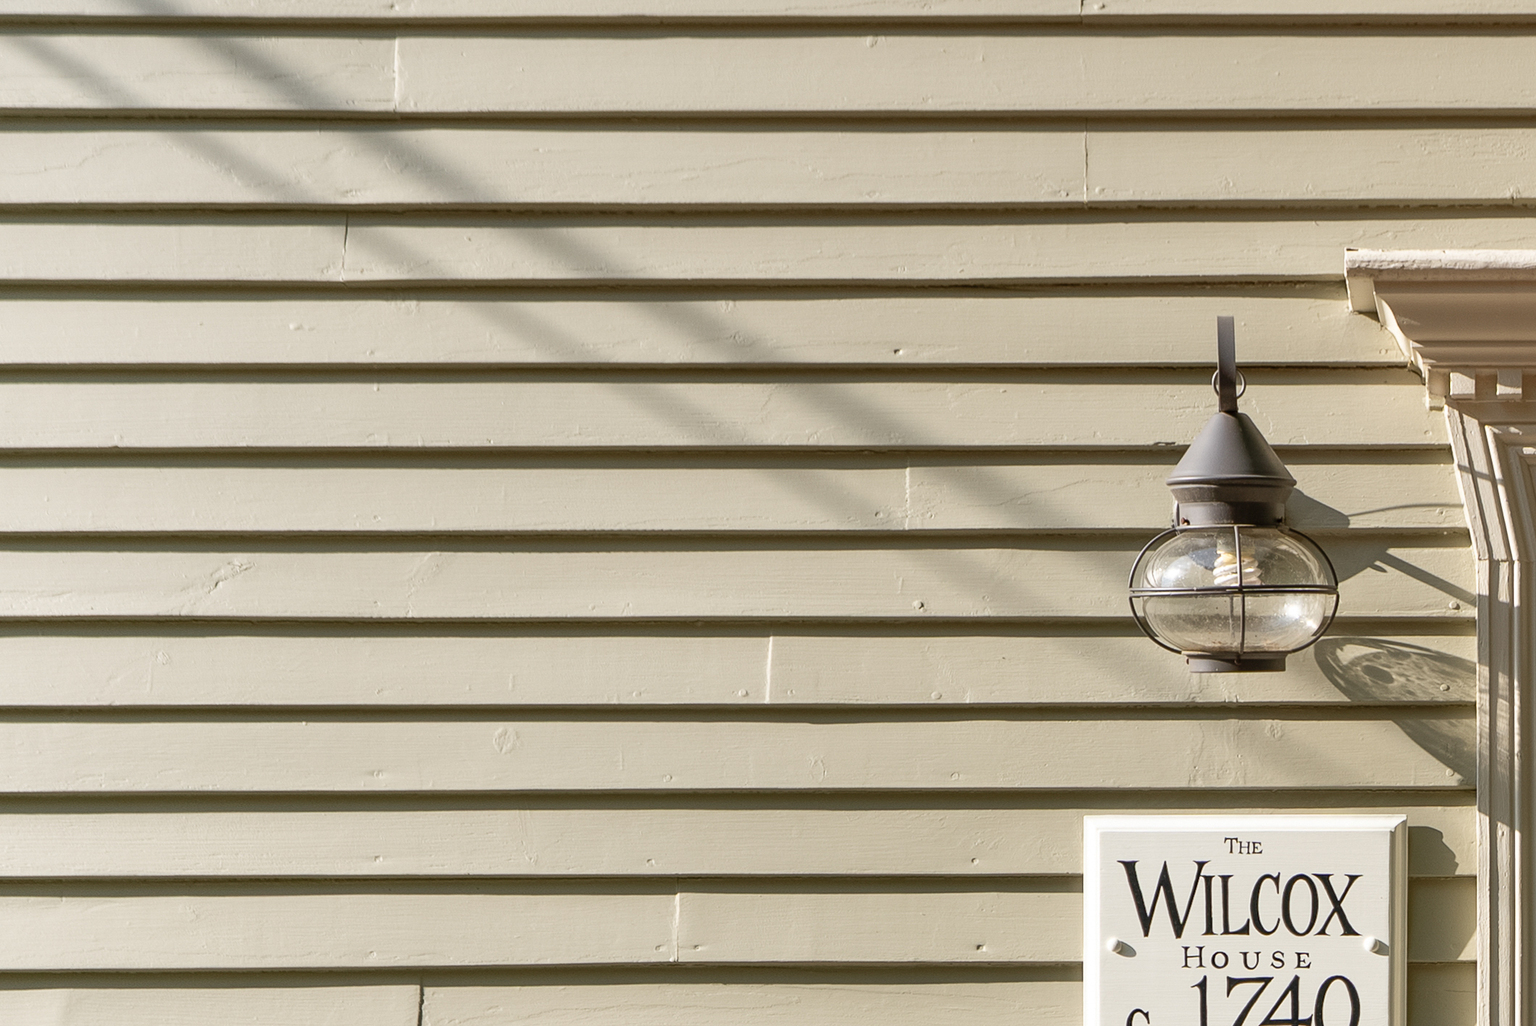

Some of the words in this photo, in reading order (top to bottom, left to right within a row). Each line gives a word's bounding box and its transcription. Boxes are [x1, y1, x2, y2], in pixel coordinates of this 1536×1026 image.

[1223, 836, 1264, 855] THE
[1116, 859, 1364, 940] WILCOX
[1181, 945, 1313, 970] HOUSE
